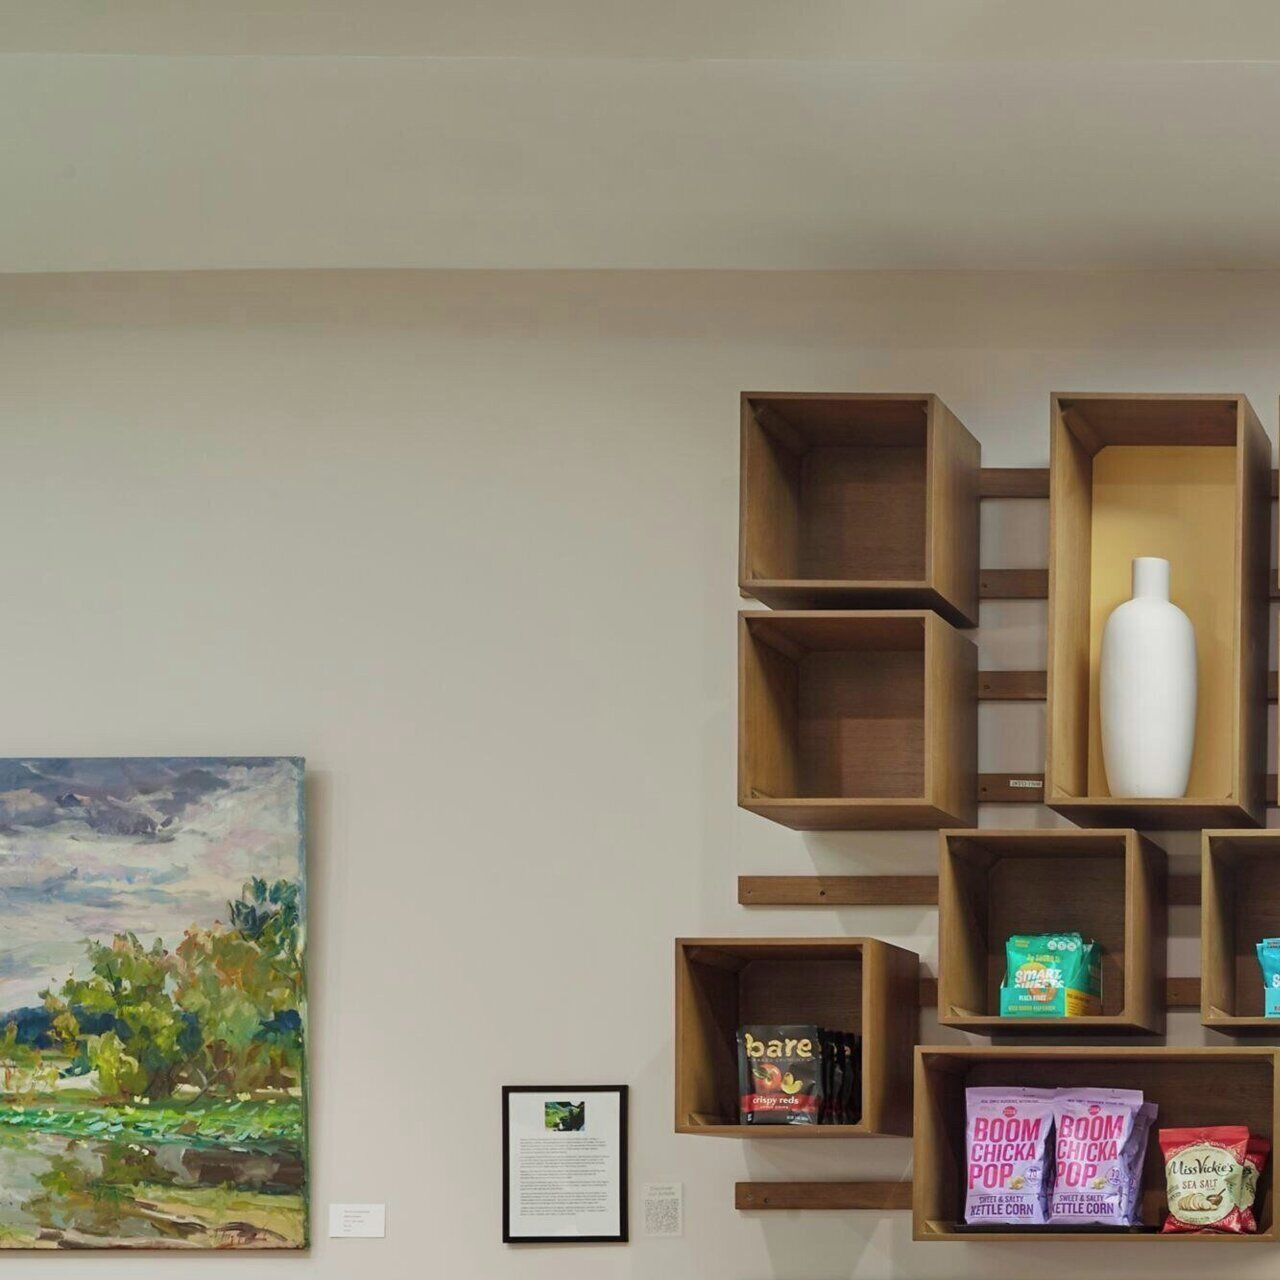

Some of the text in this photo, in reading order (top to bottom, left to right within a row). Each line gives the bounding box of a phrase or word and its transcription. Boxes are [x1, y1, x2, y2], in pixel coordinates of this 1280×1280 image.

[744, 1032, 812, 1058] bare
[753, 1096, 799, 1107] crispy reds
[973, 1118, 1042, 1143] BOOM
[1058, 1115, 1124, 1141] BOOM
[971, 1143, 1036, 1162] CHICKA
[1058, 1140, 1118, 1162] CHICKA
[969, 1163, 1014, 1189] POP
[1056, 1163, 1097, 1188] POP
[1182, 1179, 1218, 1190] SEA SALT
[970, 1204, 1034, 1216] KETTLE CORN
[1086, 1203, 1114, 1214] CORN
